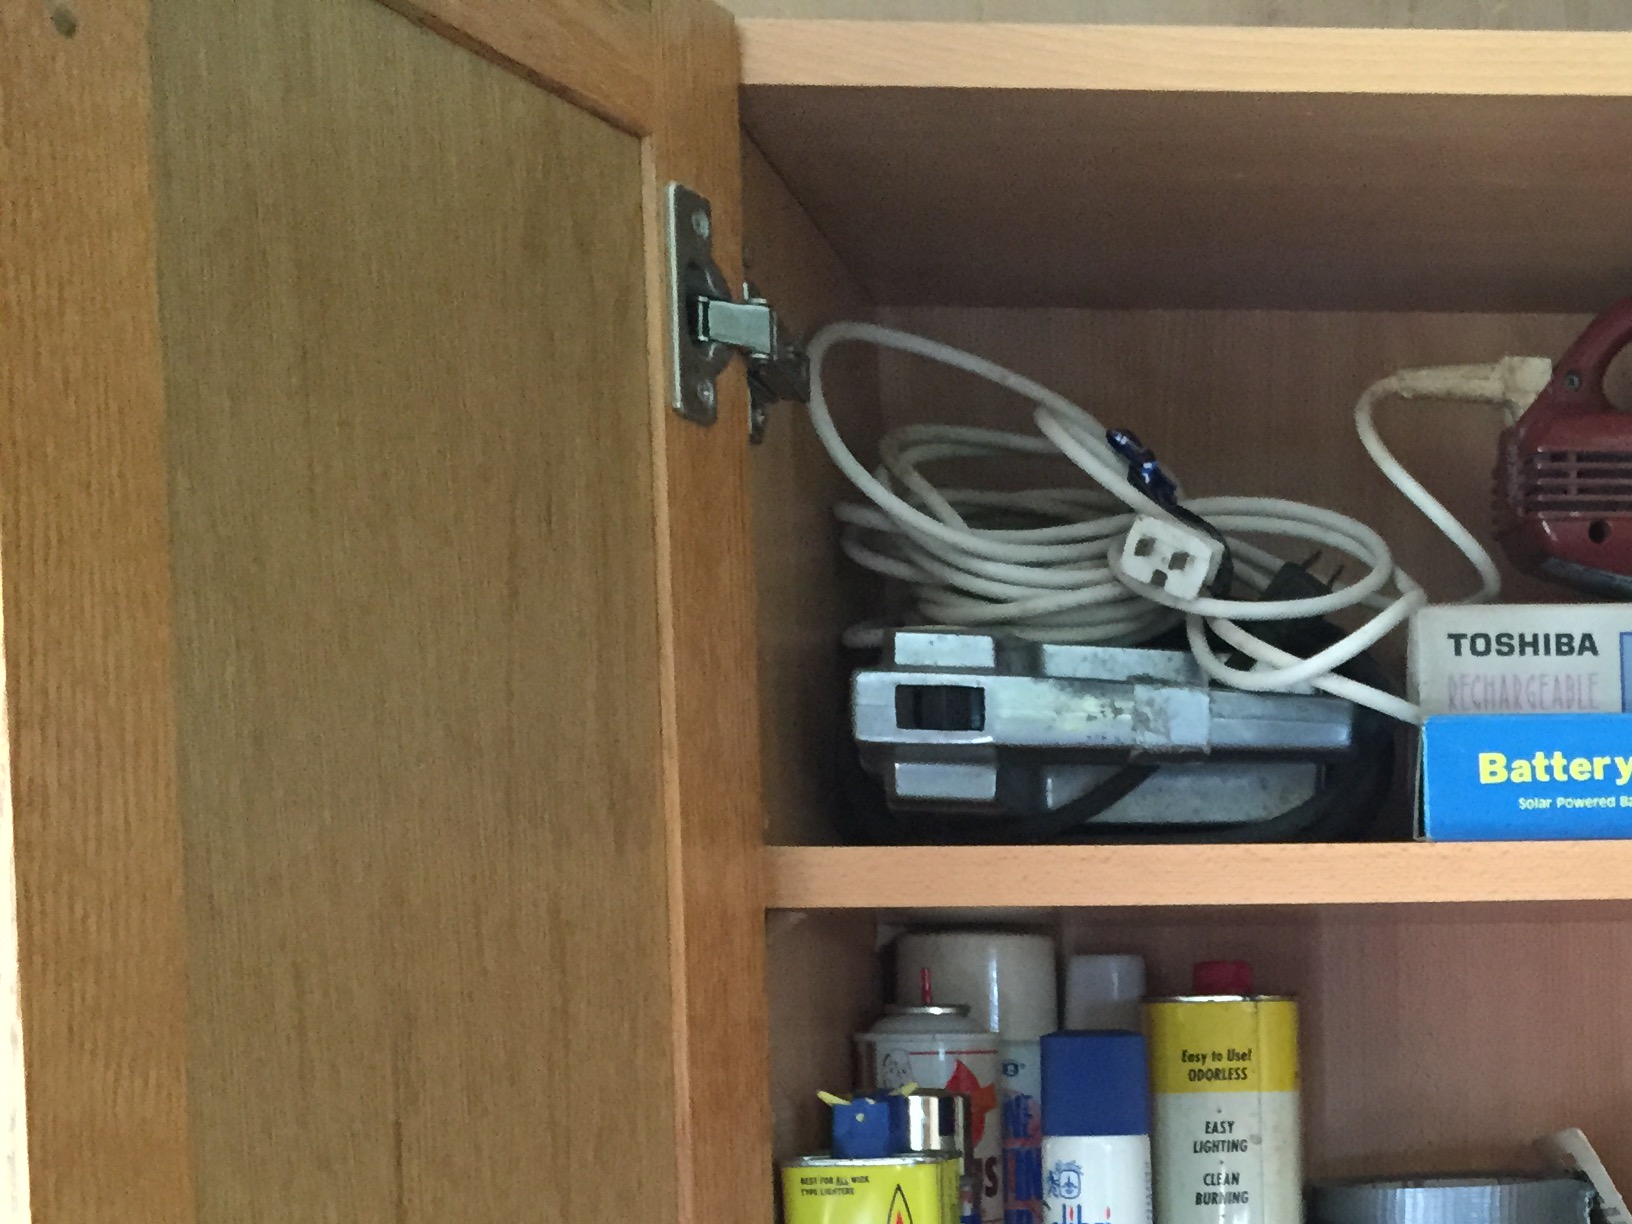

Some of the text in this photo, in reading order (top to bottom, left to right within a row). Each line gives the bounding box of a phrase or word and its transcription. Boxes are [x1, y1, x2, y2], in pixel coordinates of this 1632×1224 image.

[1447, 633, 1599, 657] TOSHIBA
[1448, 672, 1600, 711] RECHARGEABLE
[1518, 796, 1552, 810] Solar
[1556, 794, 1616, 809] Powered
[1181, 1049, 1207, 1065] Easy
[1211, 1050, 1223, 1062] to
[1188, 1067, 1248, 1082] ODORLESS
[1204, 1120, 1235, 1134] EASY
[1193, 1139, 1249, 1154] LIGHTING
[836, 1176, 849, 1186] ALL
[1202, 1172, 1240, 1187] CLEAN
[1195, 1190, 1249, 1206] BURNING
